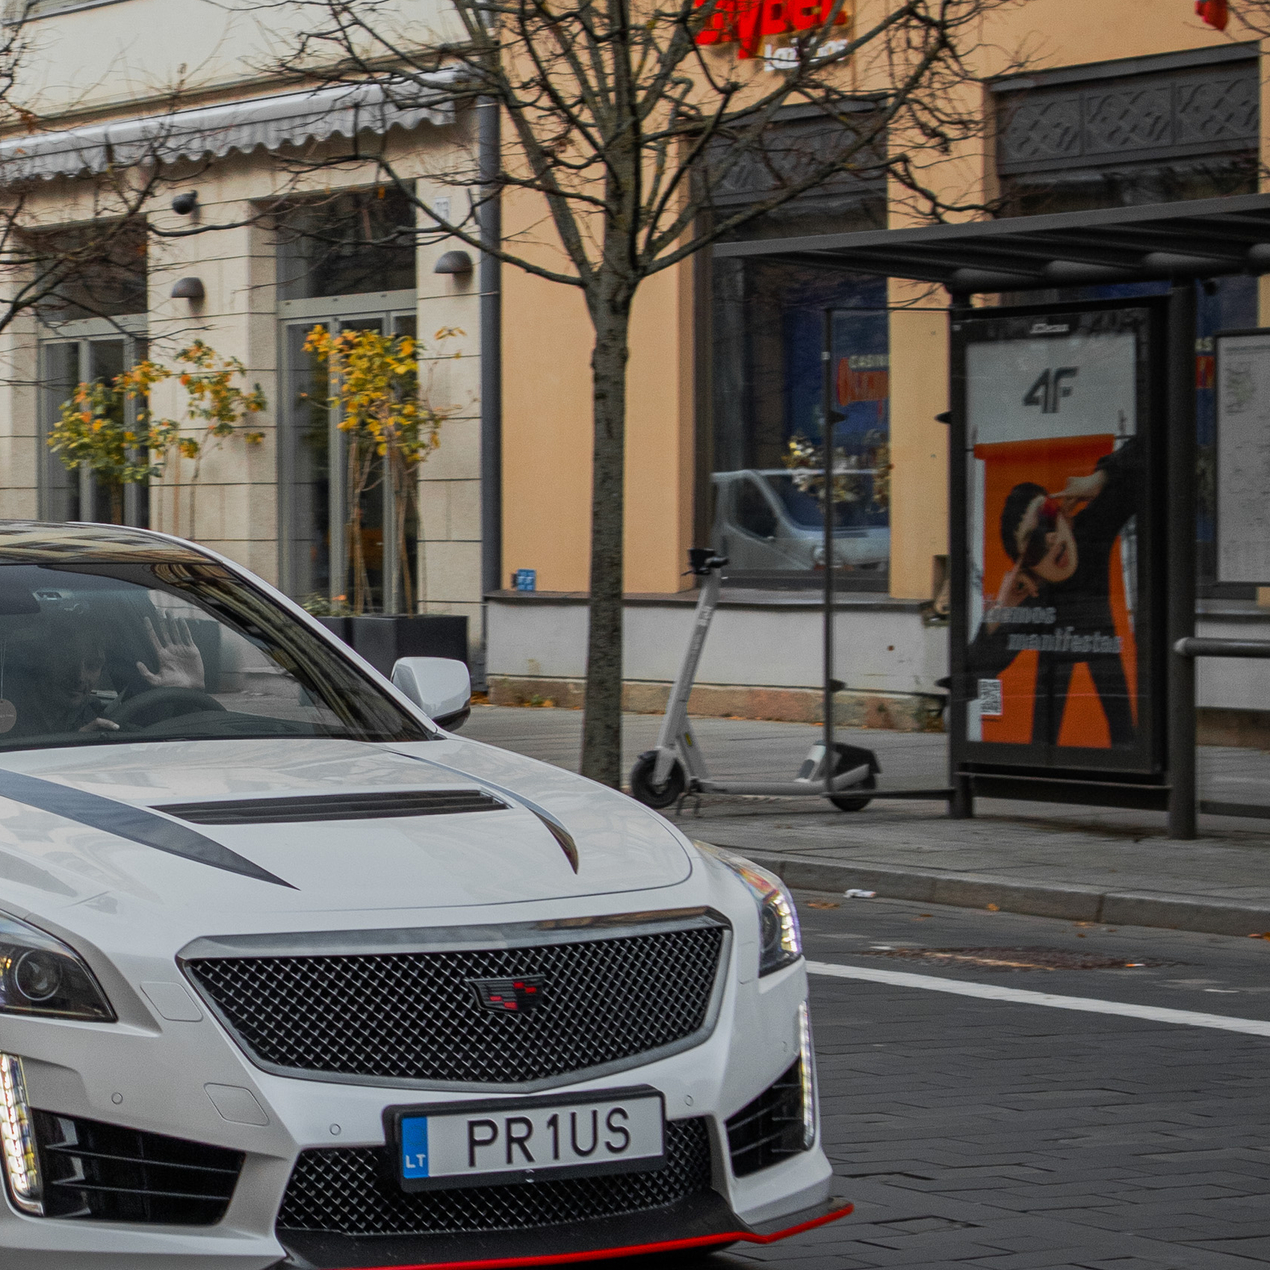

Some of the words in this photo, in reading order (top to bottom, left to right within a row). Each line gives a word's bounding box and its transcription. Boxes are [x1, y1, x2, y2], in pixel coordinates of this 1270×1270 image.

[1022, 366, 1080, 414] 4F
[405, 1153, 426, 1169] LT
[466, 1106, 631, 1168] PR1US
